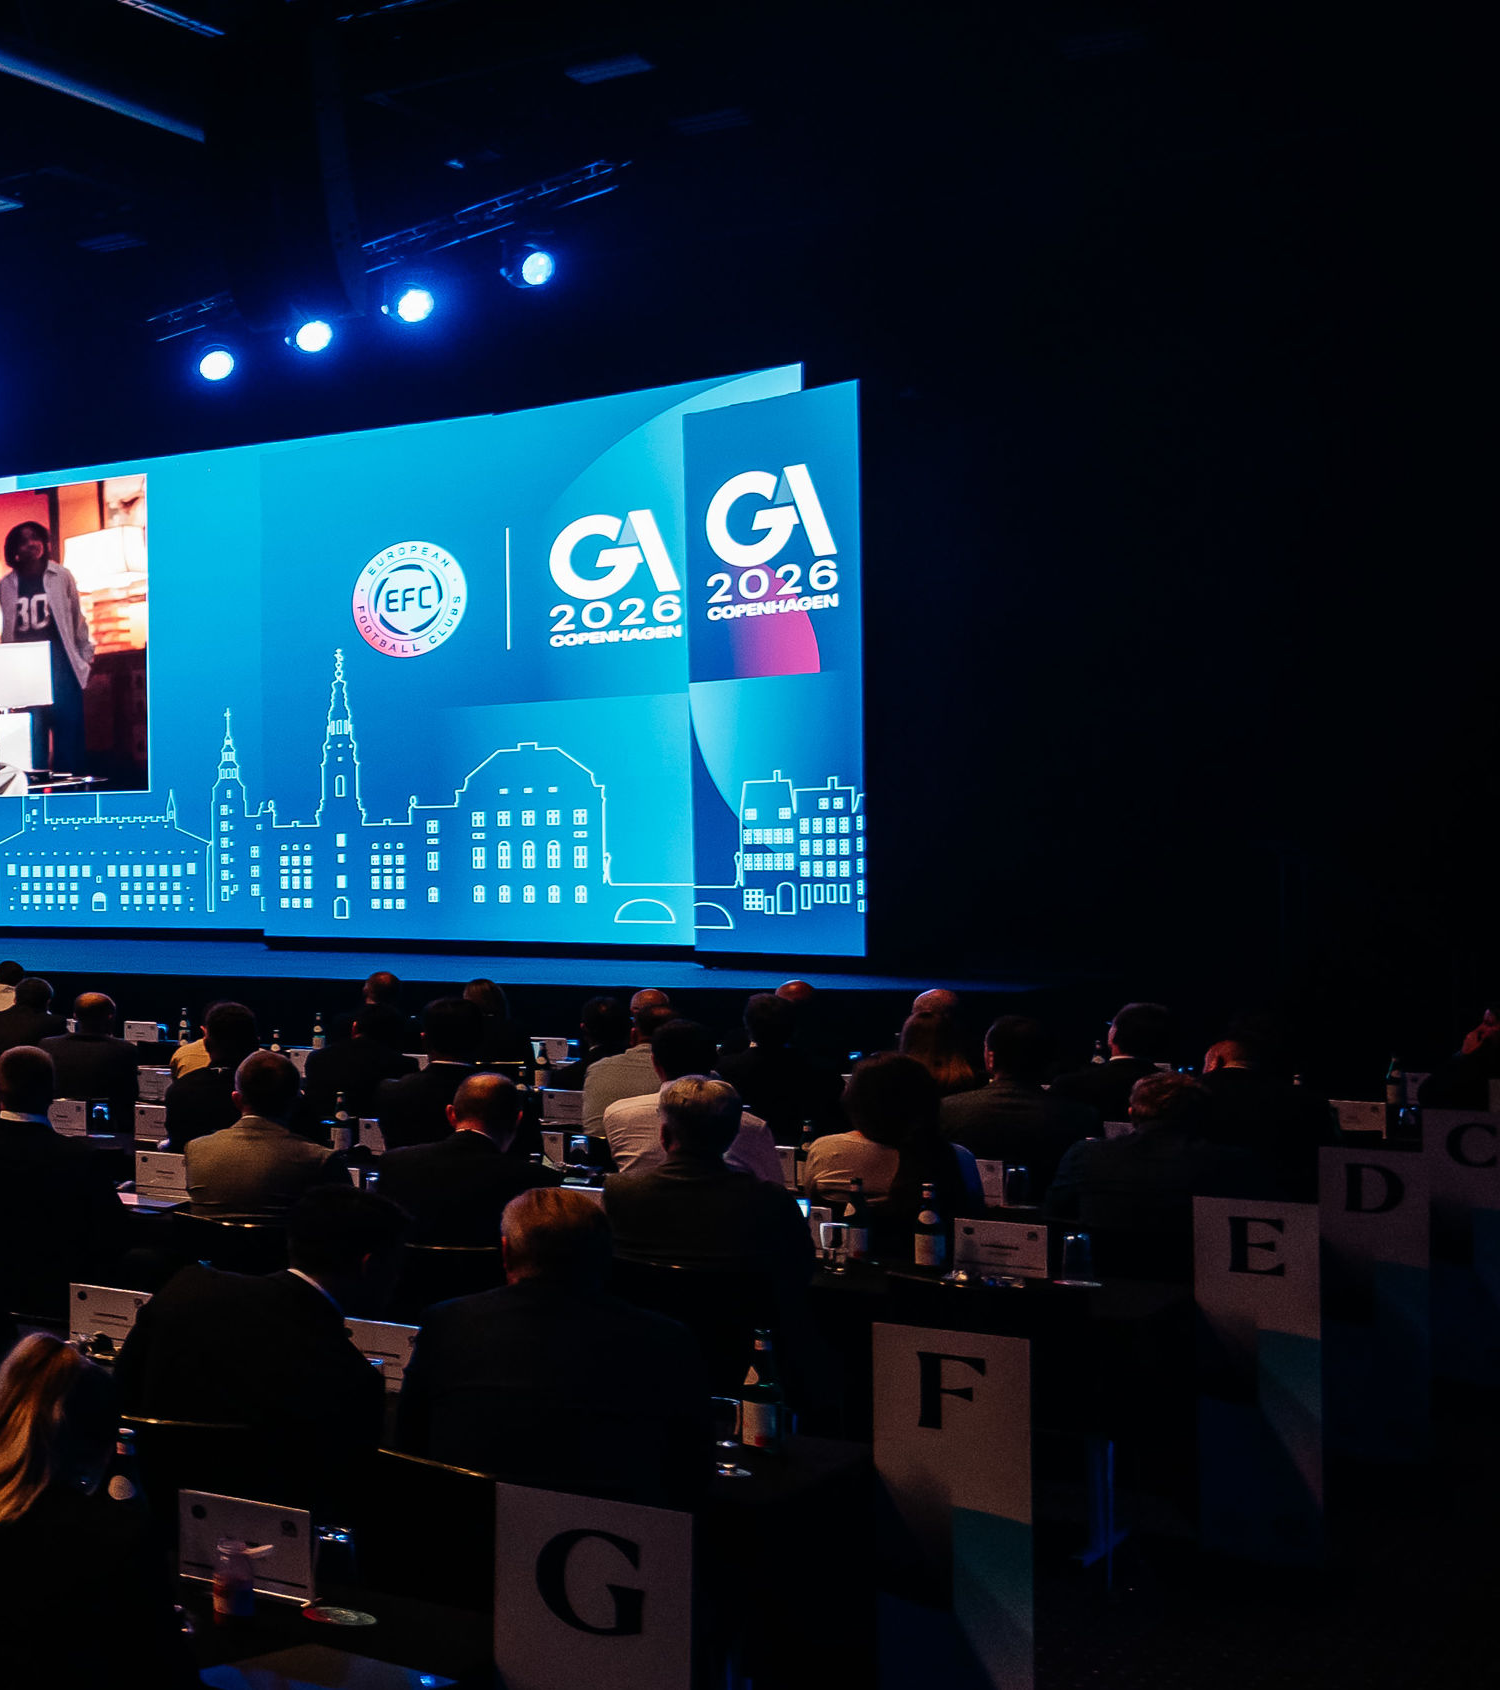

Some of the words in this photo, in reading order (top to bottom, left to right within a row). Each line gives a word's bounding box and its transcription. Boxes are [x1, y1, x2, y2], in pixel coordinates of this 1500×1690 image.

[705, 463, 838, 567] GA
[368, 545, 450, 575] EUROPEAN
[549, 509, 681, 600] GA
[385, 586, 432, 612] EFC
[706, 559, 839, 604] 2026
[357, 605, 421, 653] FOOTBALL
[429, 596, 461, 644] CLUBS
[549, 594, 682, 632] 2026
[706, 593, 839, 621] COPENHAGEN
[550, 624, 682, 648] COPENHAGEN
[1447, 1123, 1497, 1168] C
[1345, 1163, 1404, 1213] D
[1228, 1216, 1285, 1276] E
[916, 1351, 986, 1430] F
[535, 1528, 645, 1636] G
